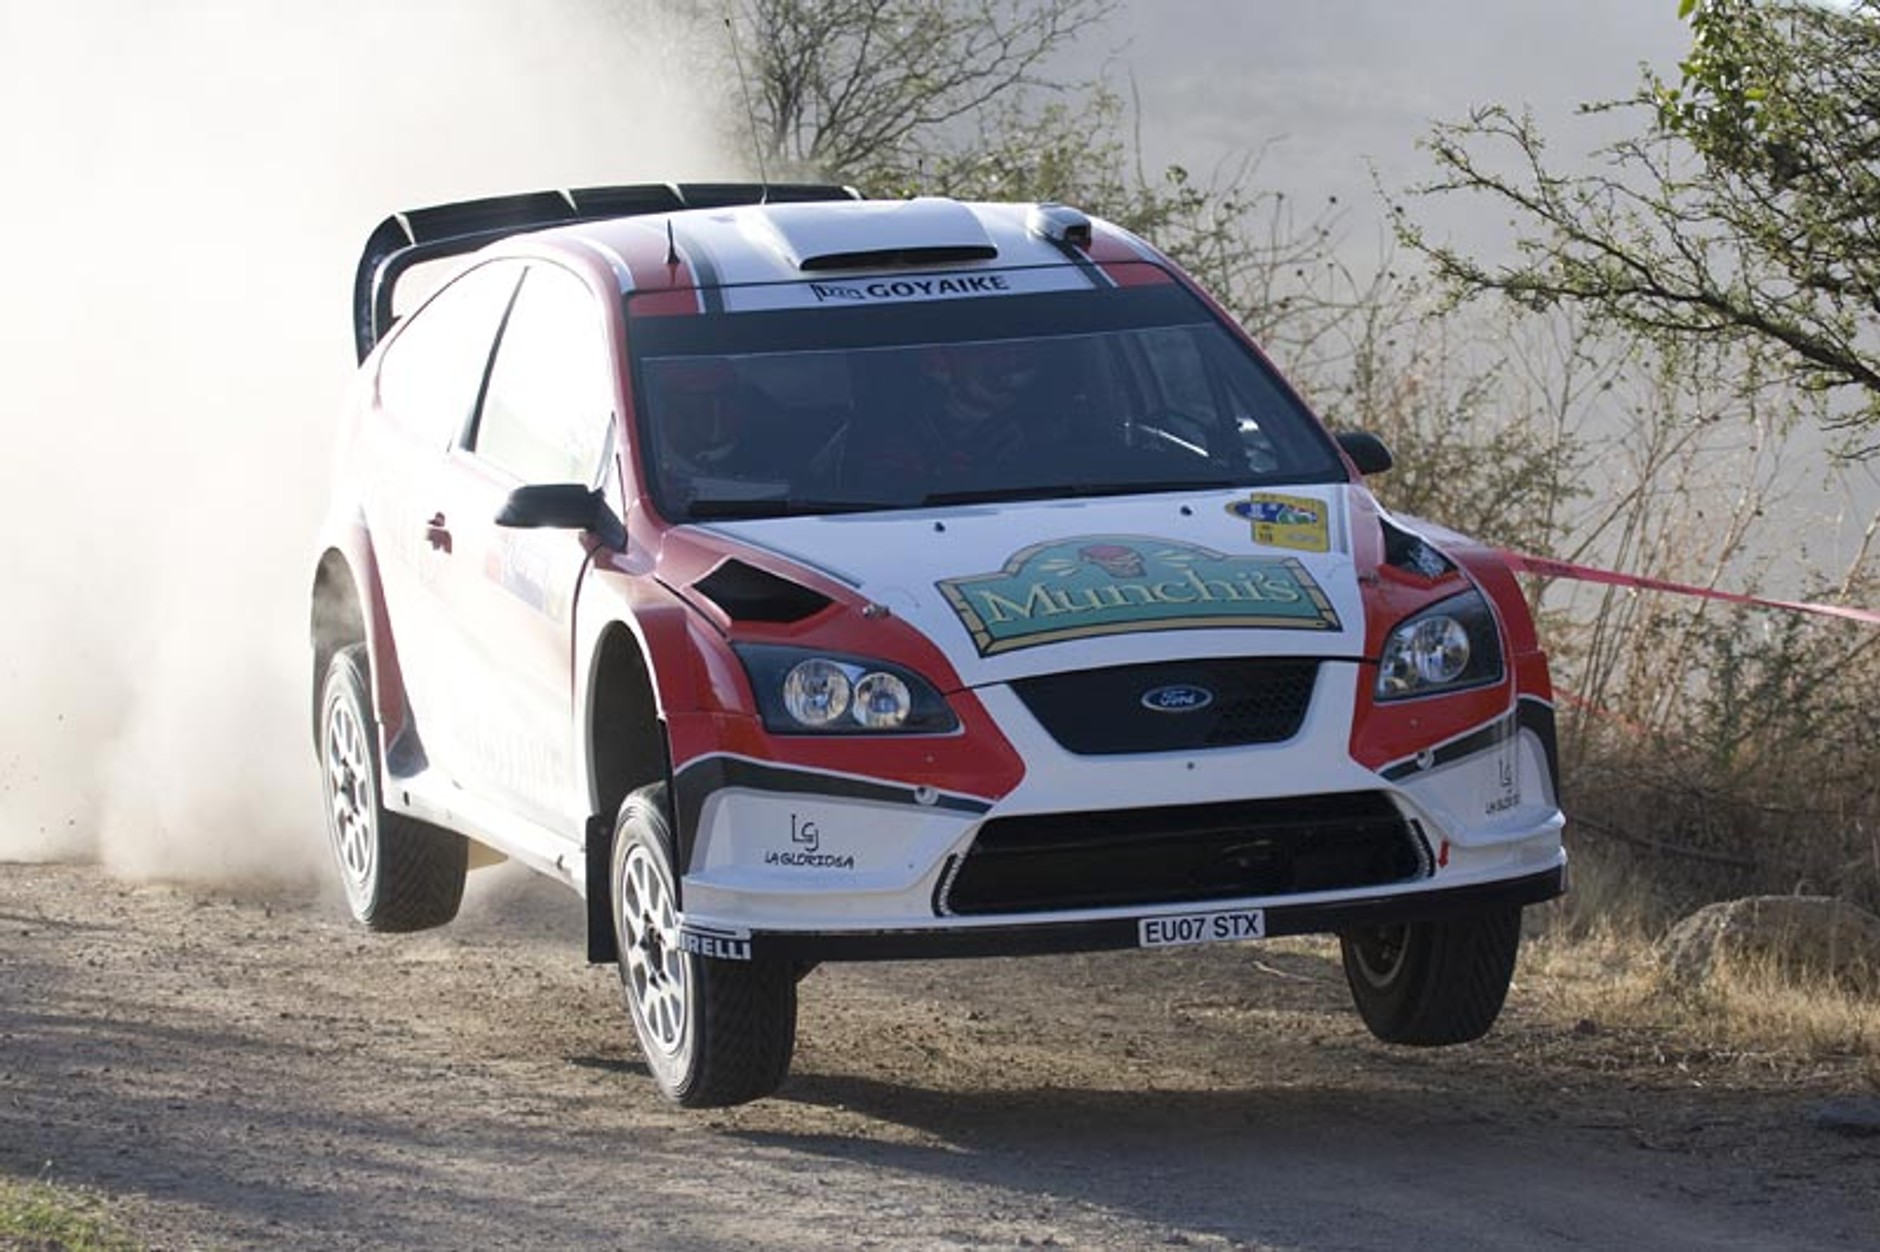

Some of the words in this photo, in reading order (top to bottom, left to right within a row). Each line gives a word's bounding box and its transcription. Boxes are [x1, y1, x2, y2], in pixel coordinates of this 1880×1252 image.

[867, 275, 1009, 297] GOYAIKE
[980, 569, 1300, 622] Munchi's
[1145, 919, 1206, 943] EU07
[1213, 914, 1258, 938] STX
